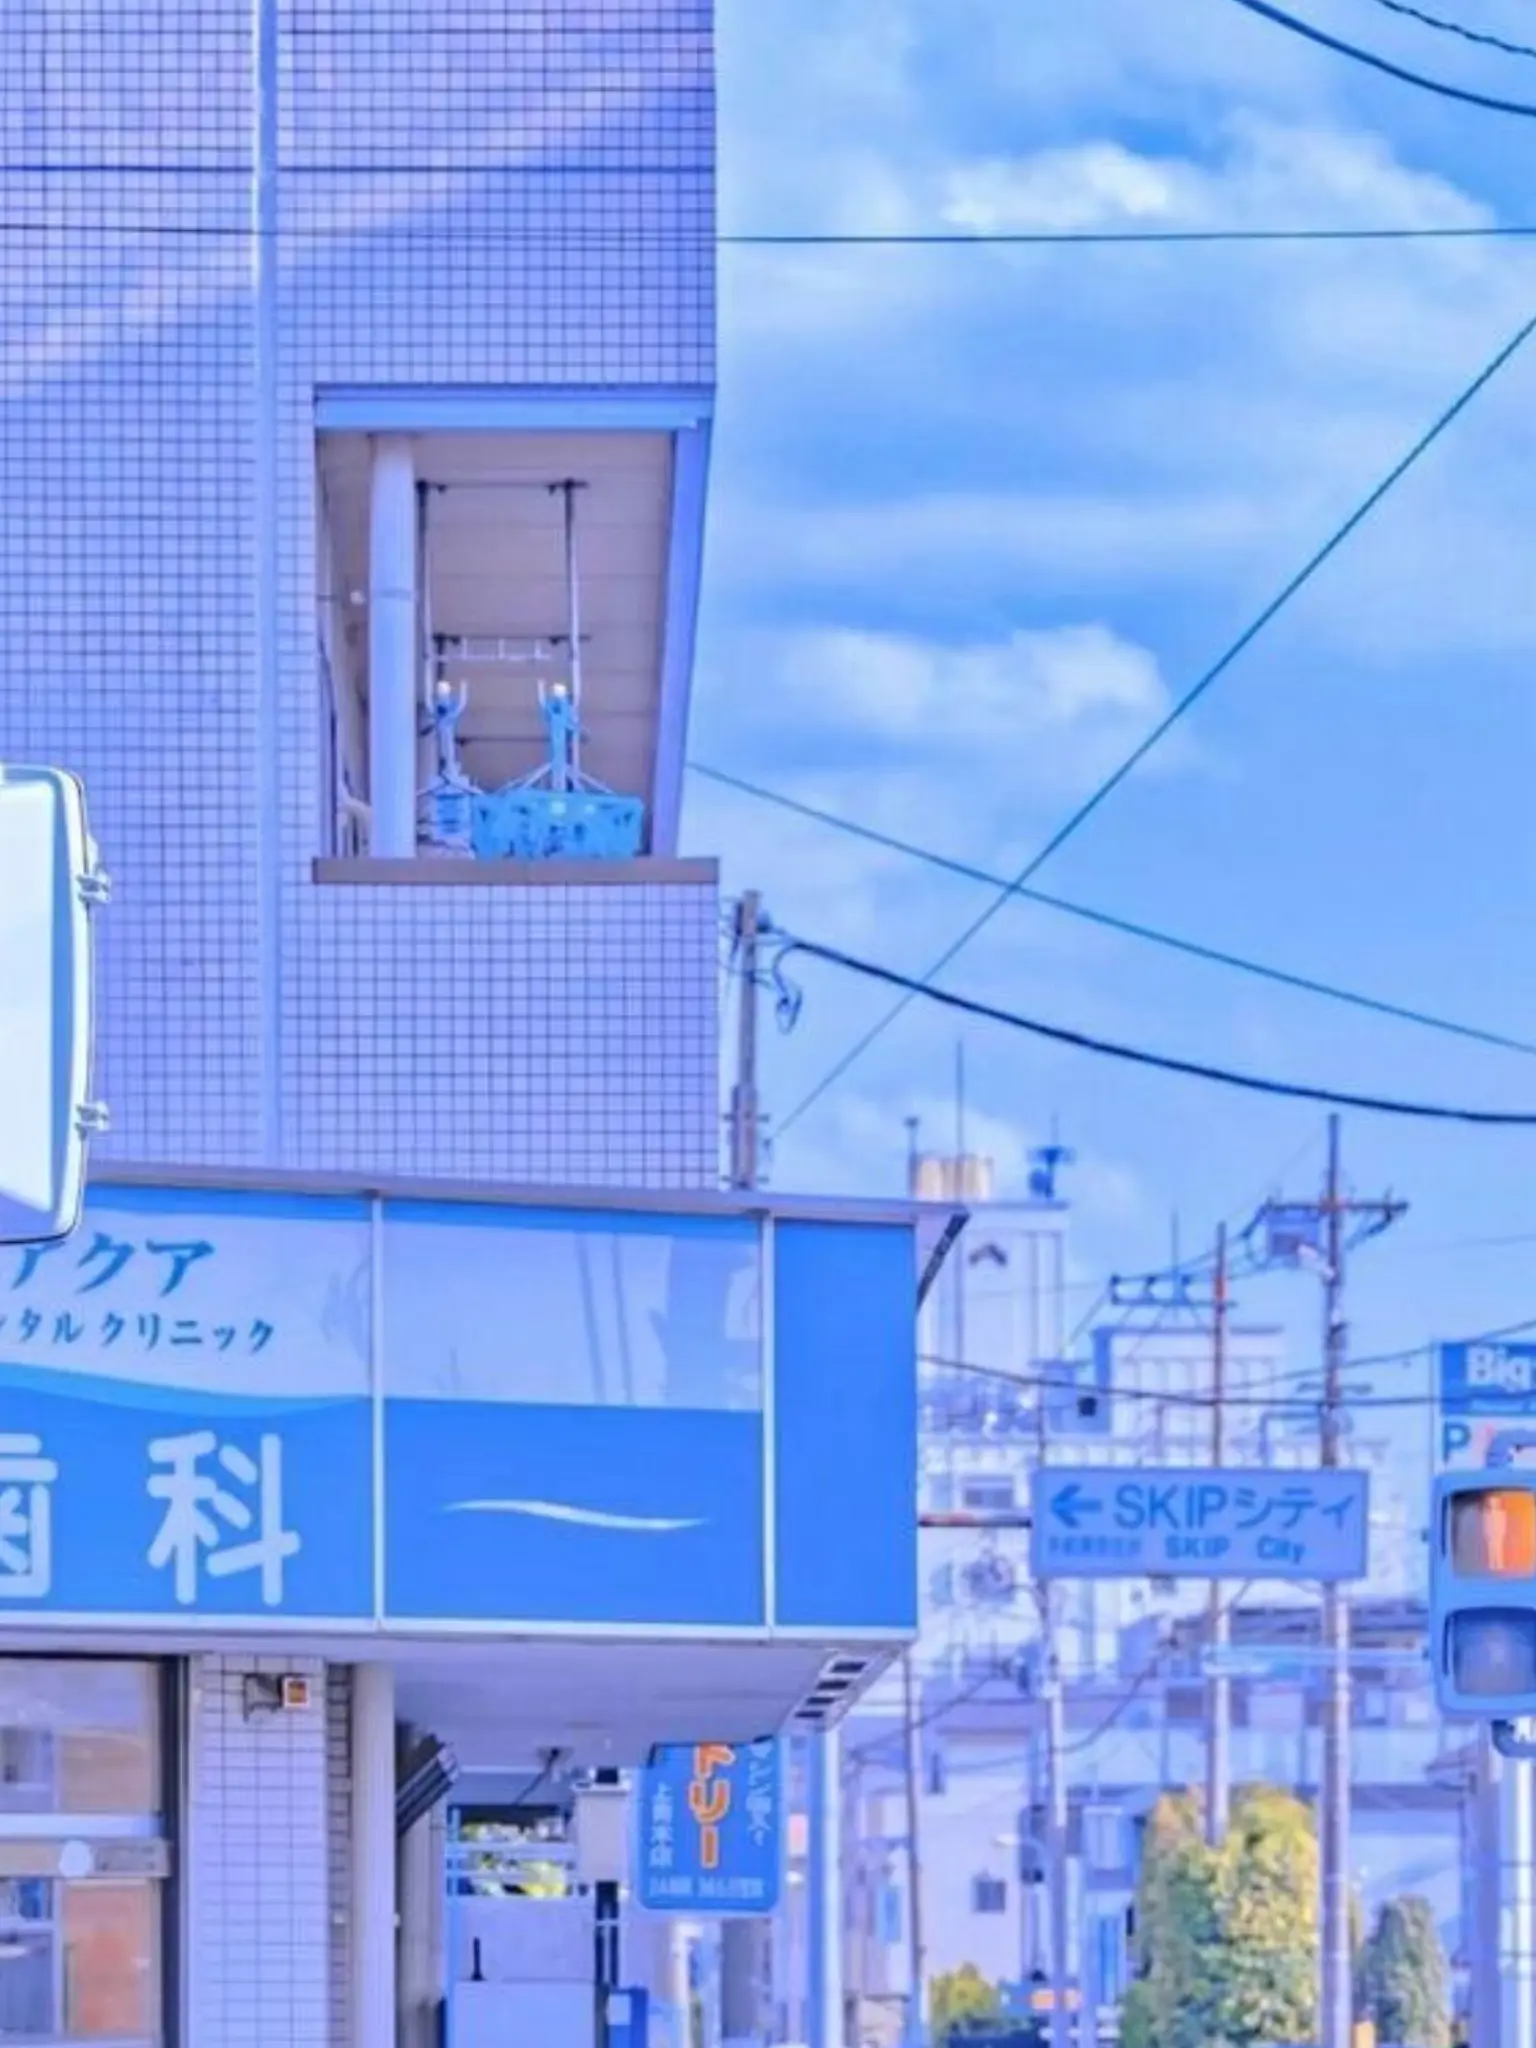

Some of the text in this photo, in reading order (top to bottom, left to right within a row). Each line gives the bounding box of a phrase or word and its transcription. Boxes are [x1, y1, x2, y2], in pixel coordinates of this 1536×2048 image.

[0, 1308, 275, 1353] タルクリニック
[1112, 1484, 1356, 1530] SKIPシティ
[1164, 1535, 1231, 1560] SKIP
